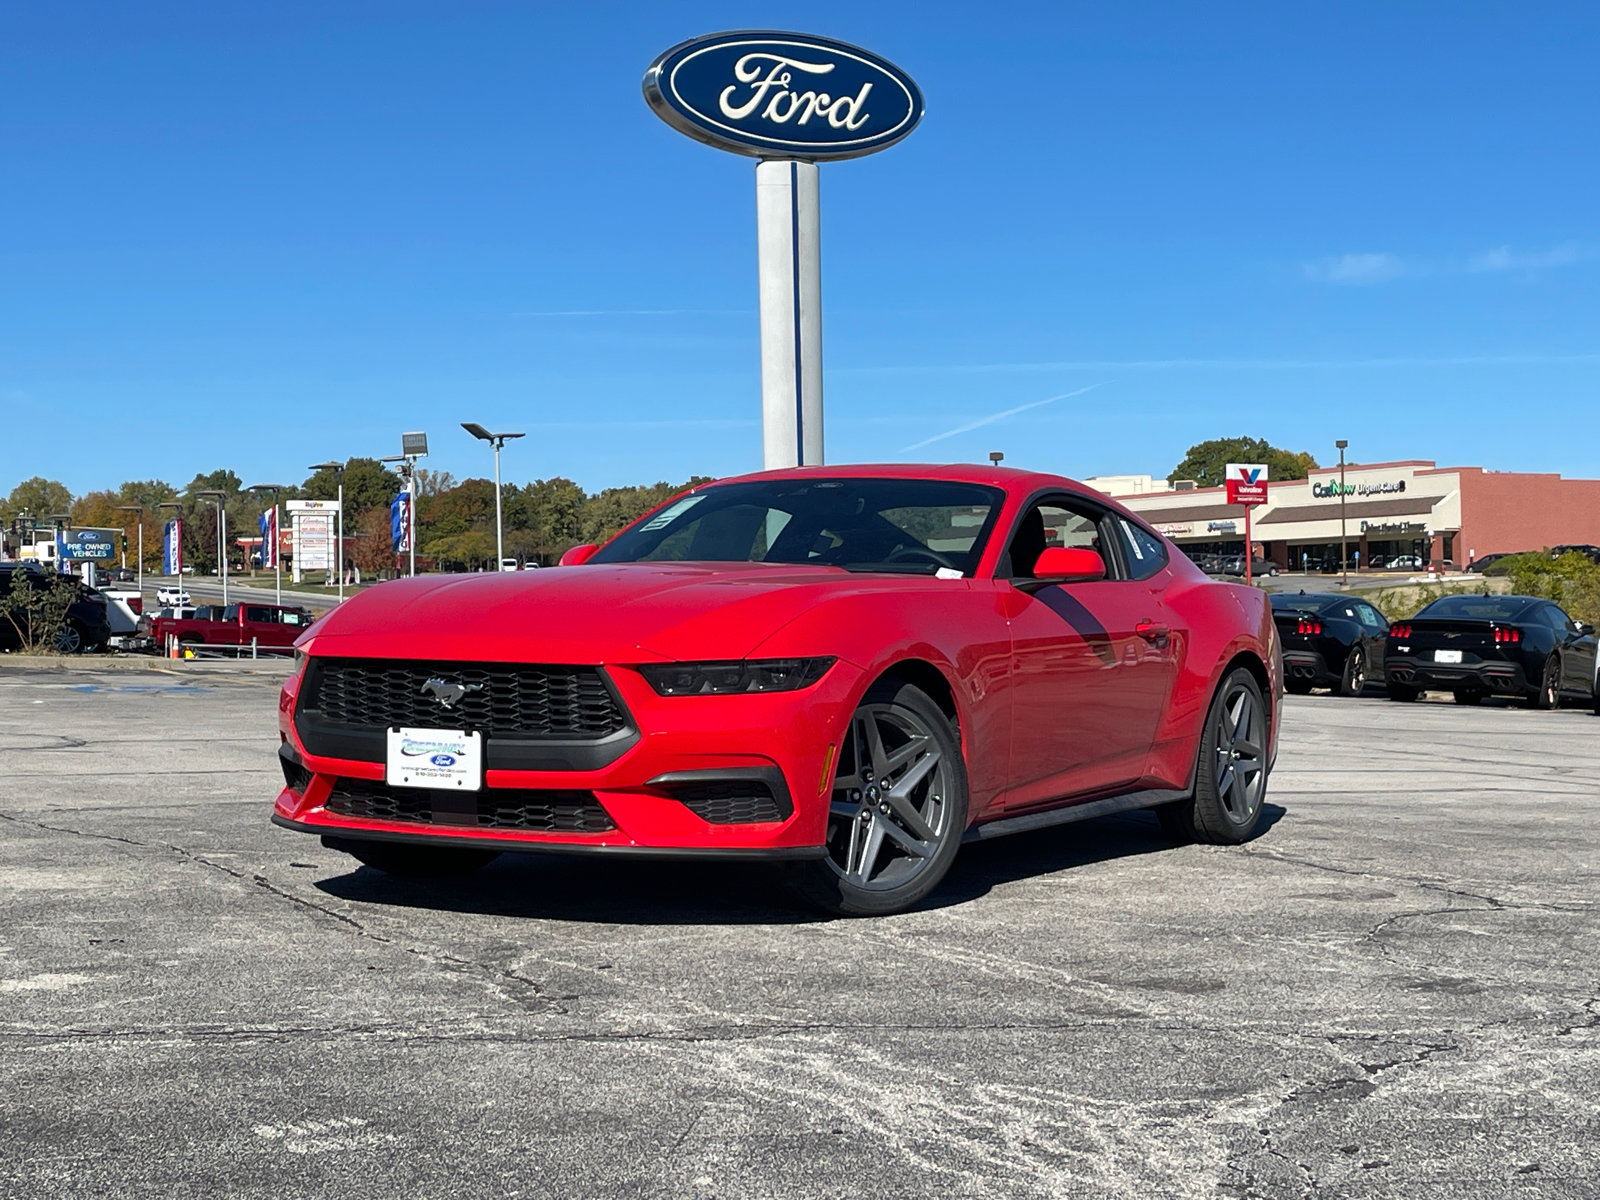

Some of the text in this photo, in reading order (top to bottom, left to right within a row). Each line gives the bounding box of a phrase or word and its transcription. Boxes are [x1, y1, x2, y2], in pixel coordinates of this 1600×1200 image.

[719, 53, 873, 130] Ford
[1358, 484, 1381, 497] Urgent
[72, 550, 107, 558] VEHICLES
[435, 755, 453, 765] Ford
